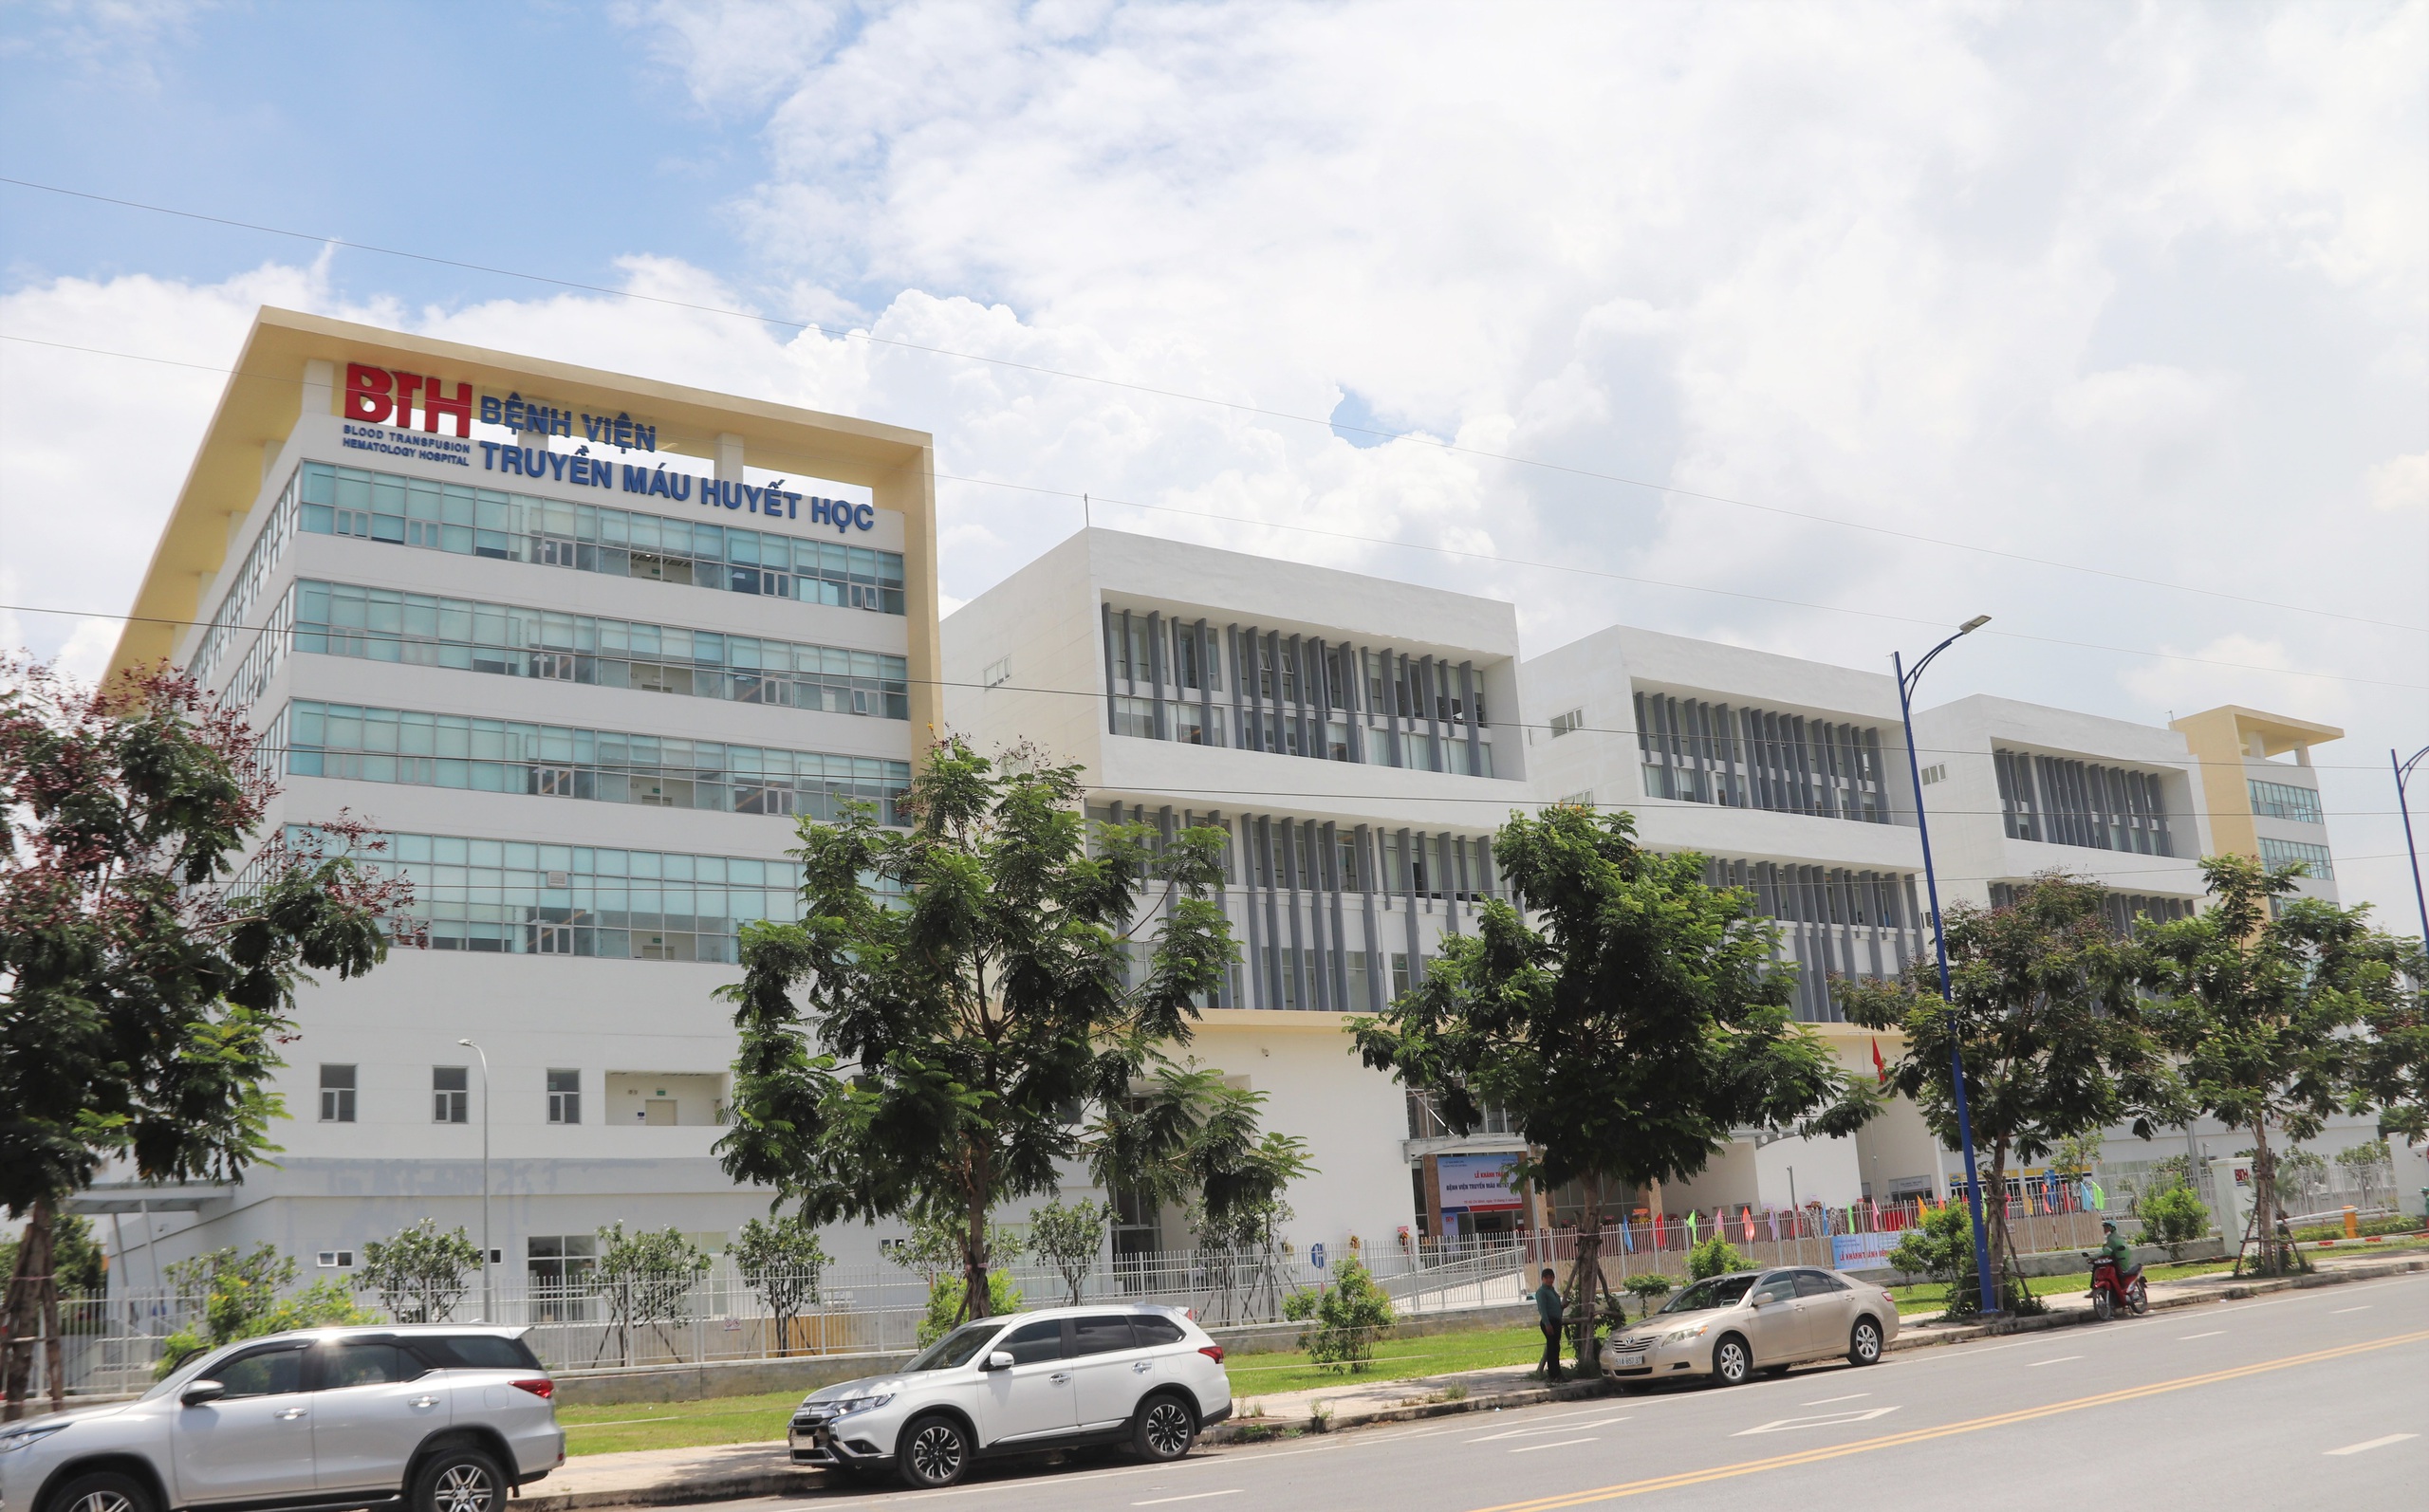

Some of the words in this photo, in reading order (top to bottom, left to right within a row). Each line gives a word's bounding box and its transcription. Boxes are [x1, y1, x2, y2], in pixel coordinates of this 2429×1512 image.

[344, 362, 473, 439] BTH
[480, 392, 571, 437] BỆNH
[581, 412, 656, 453] VIỆN
[343, 424, 383, 439] BLOOD
[389, 432, 470, 453] TRANSFUSION
[343, 437, 417, 458] HEMATOLOGY
[418, 450, 470, 467] HOSPITAL
[479, 440, 612, 489] TRUYỀN
[623, 462, 691, 502] MÁU
[701, 479, 802, 519] HUYẾT
[811, 496, 874, 533] HỌC
